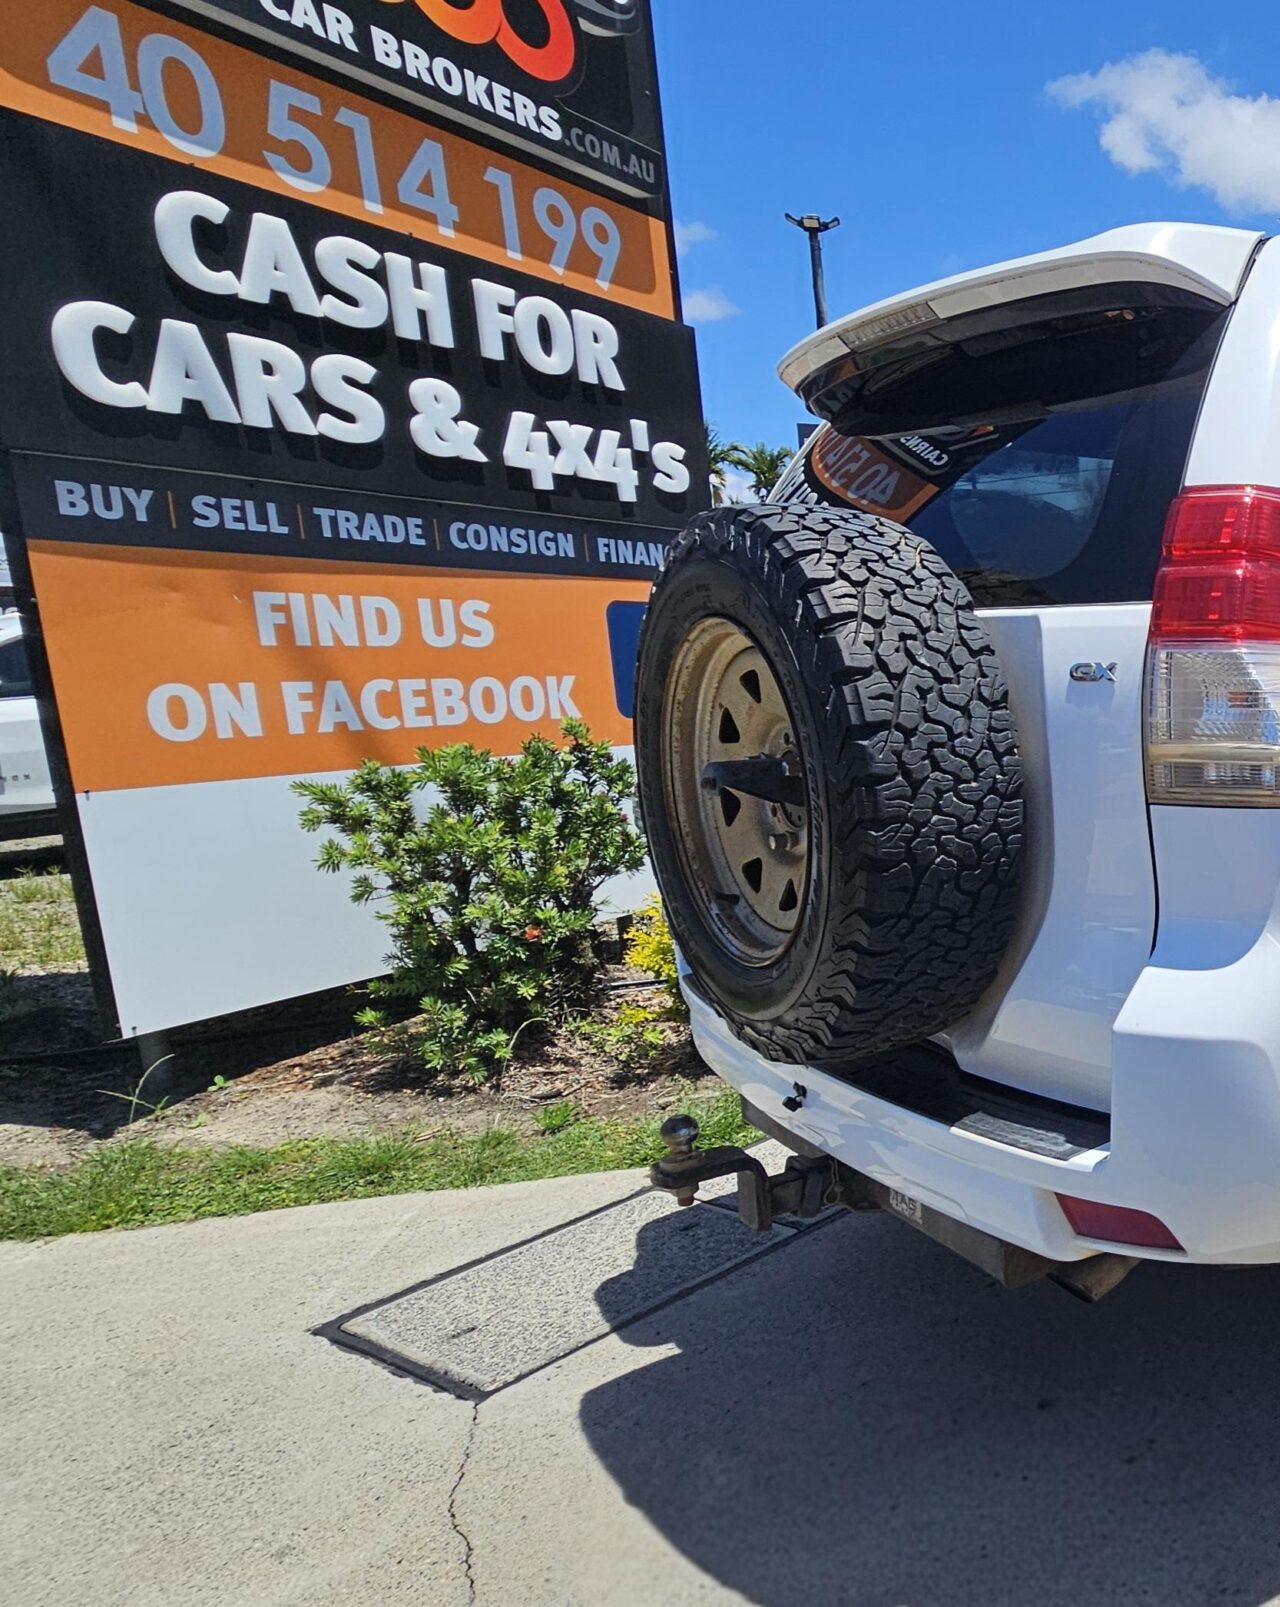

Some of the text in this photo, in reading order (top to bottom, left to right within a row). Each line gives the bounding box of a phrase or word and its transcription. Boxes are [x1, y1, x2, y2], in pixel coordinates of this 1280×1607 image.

[259, 0, 359, 52] CAR
[47, 5, 226, 158] 40
[262, 79, 459, 238] 514
[483, 167, 621, 291] 199
[154, 190, 625, 391] CASH FOR
[51, 301, 386, 443] CARS
[408, 377, 489, 462] &
[54, 480, 154, 524] BUY
[192, 495, 289, 536] SELL
[313, 507, 427, 547] TRADE
[449, 521, 576, 559] CONSIGN
[252, 591, 495, 648] FIND US
[1069, 662, 1118, 681] GX
[146, 675, 582, 742] ON FACEBOOK
